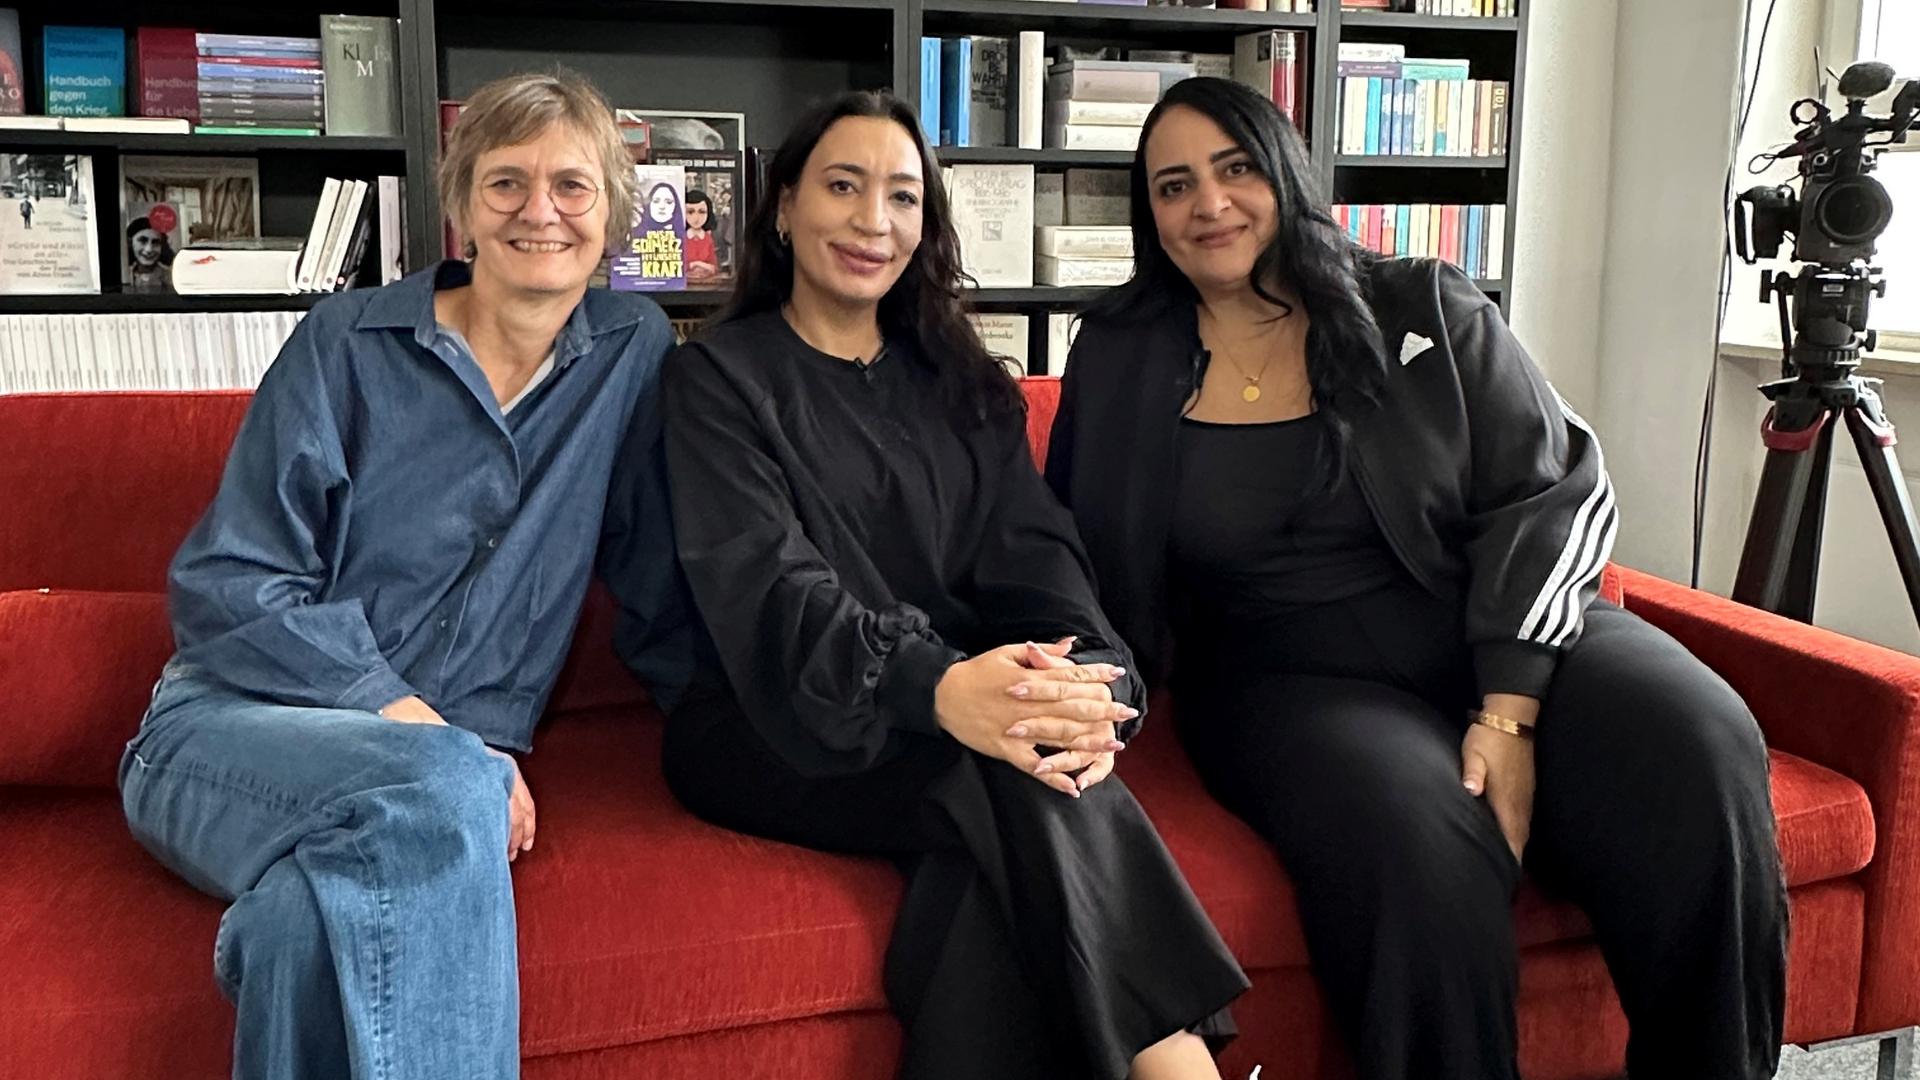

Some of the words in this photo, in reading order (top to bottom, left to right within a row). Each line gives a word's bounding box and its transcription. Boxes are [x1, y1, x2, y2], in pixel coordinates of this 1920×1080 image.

[49, 75, 111, 87] Handbuch
[145, 77, 198, 89] Handbuc
[49, 91, 87, 102] gegen
[49, 104, 73, 114] den
[642, 261, 683, 278] KRAFT
